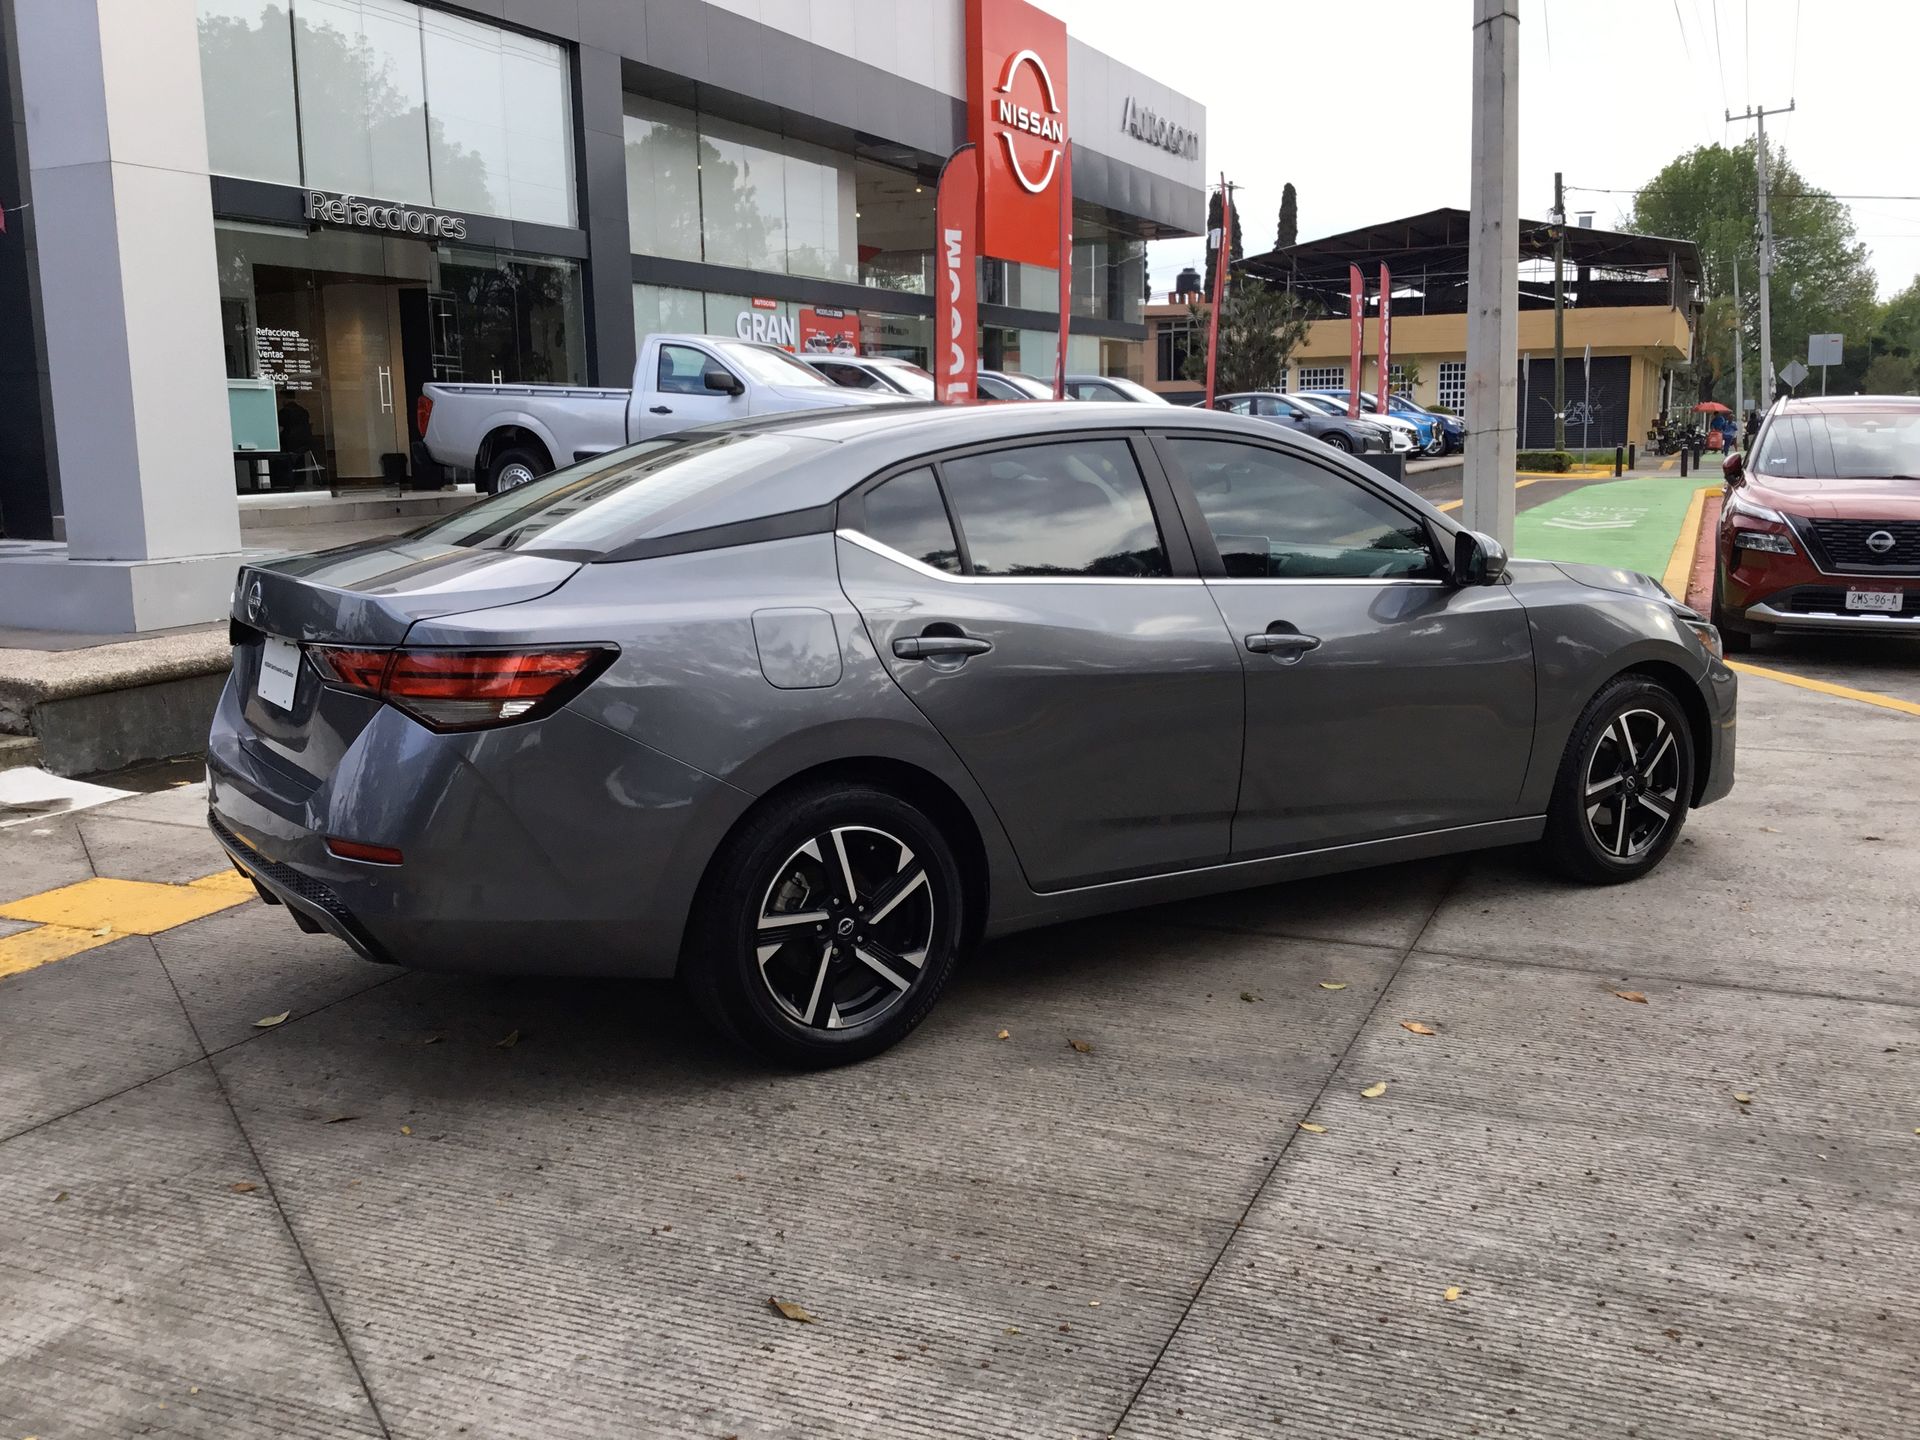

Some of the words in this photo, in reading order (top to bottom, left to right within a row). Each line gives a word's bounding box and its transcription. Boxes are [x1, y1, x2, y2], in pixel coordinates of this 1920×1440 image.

[1000, 98, 1063, 143] NISSAN
[1121, 95, 1199, 160] Autocom
[307, 190, 467, 240] Refacciones
[255, 327, 300, 338] Refacciones
[736, 311, 795, 345] GRAN
[257, 350, 284, 359] Ventas
[260, 372, 289, 381] Servicio
